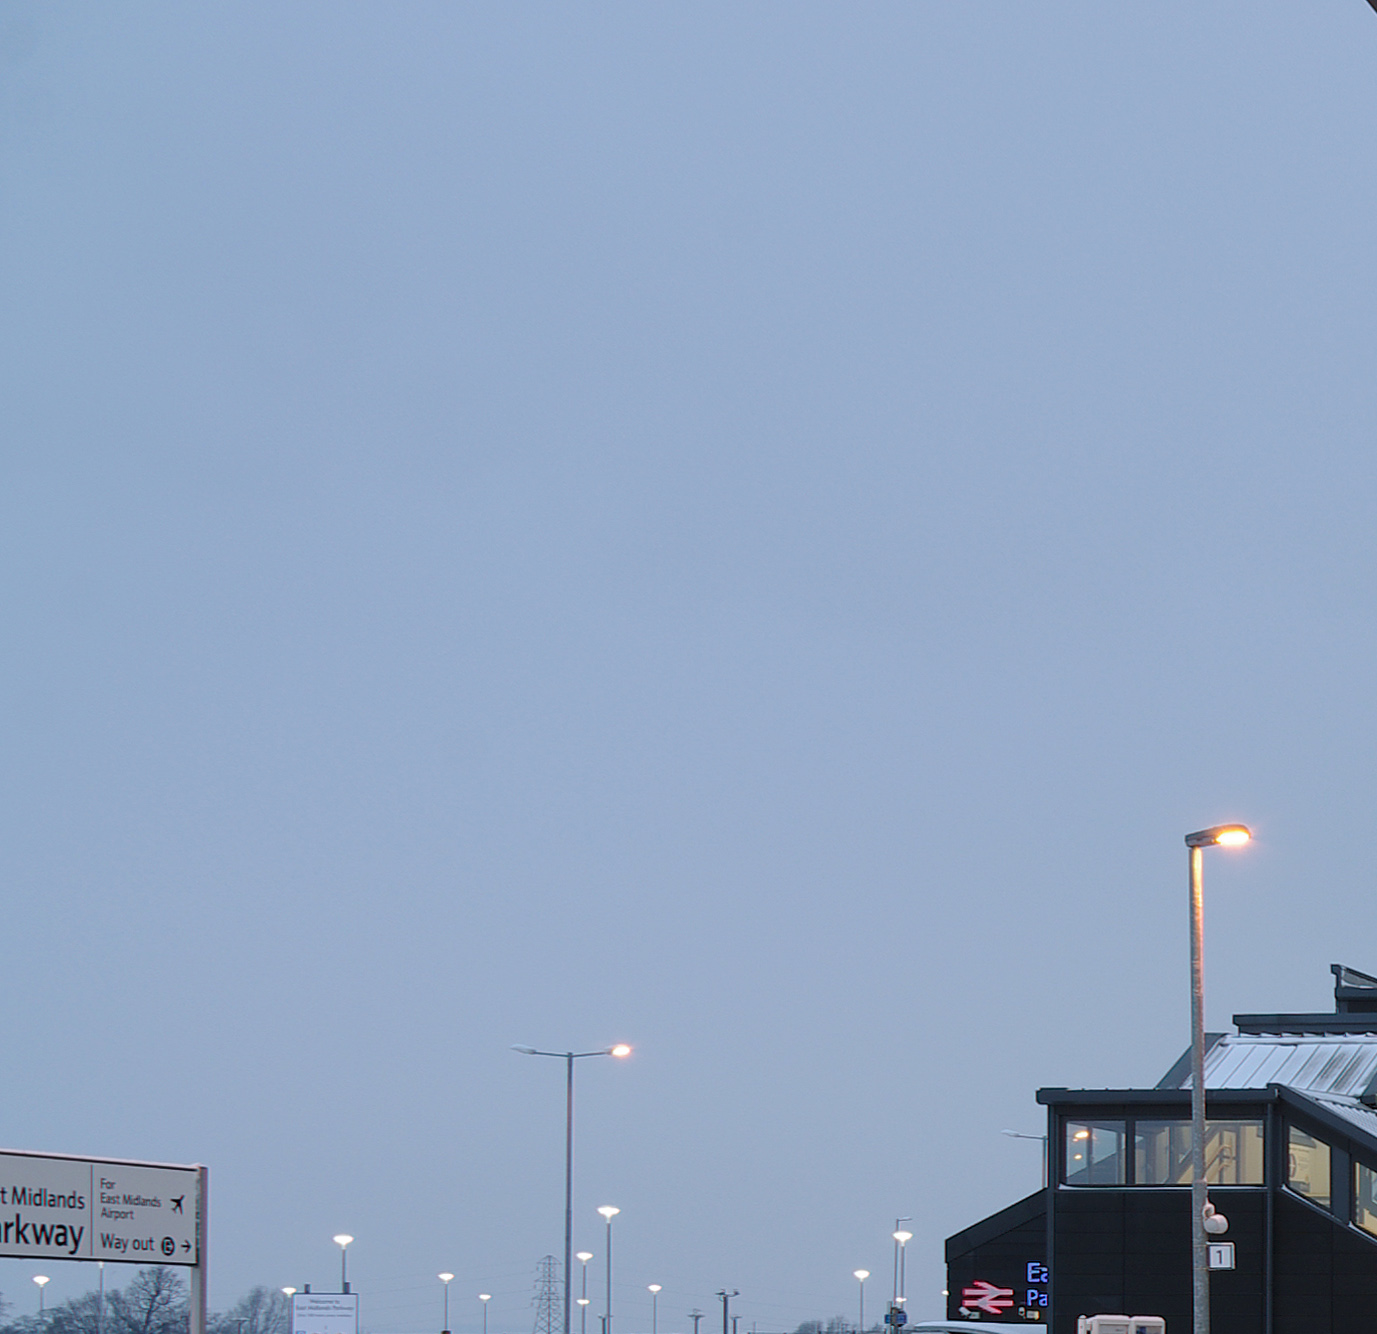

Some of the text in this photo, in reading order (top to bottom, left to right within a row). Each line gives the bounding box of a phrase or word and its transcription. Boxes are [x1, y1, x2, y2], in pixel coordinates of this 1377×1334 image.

[100, 1178, 116, 1190] For
[11, 1186, 86, 1210] Midlands
[100, 1192, 162, 1208] East Midlands
[100, 1207, 134, 1222] Airport
[100, 1232, 156, 1254] Way out
[1215, 1249, 1223, 1265] 1
